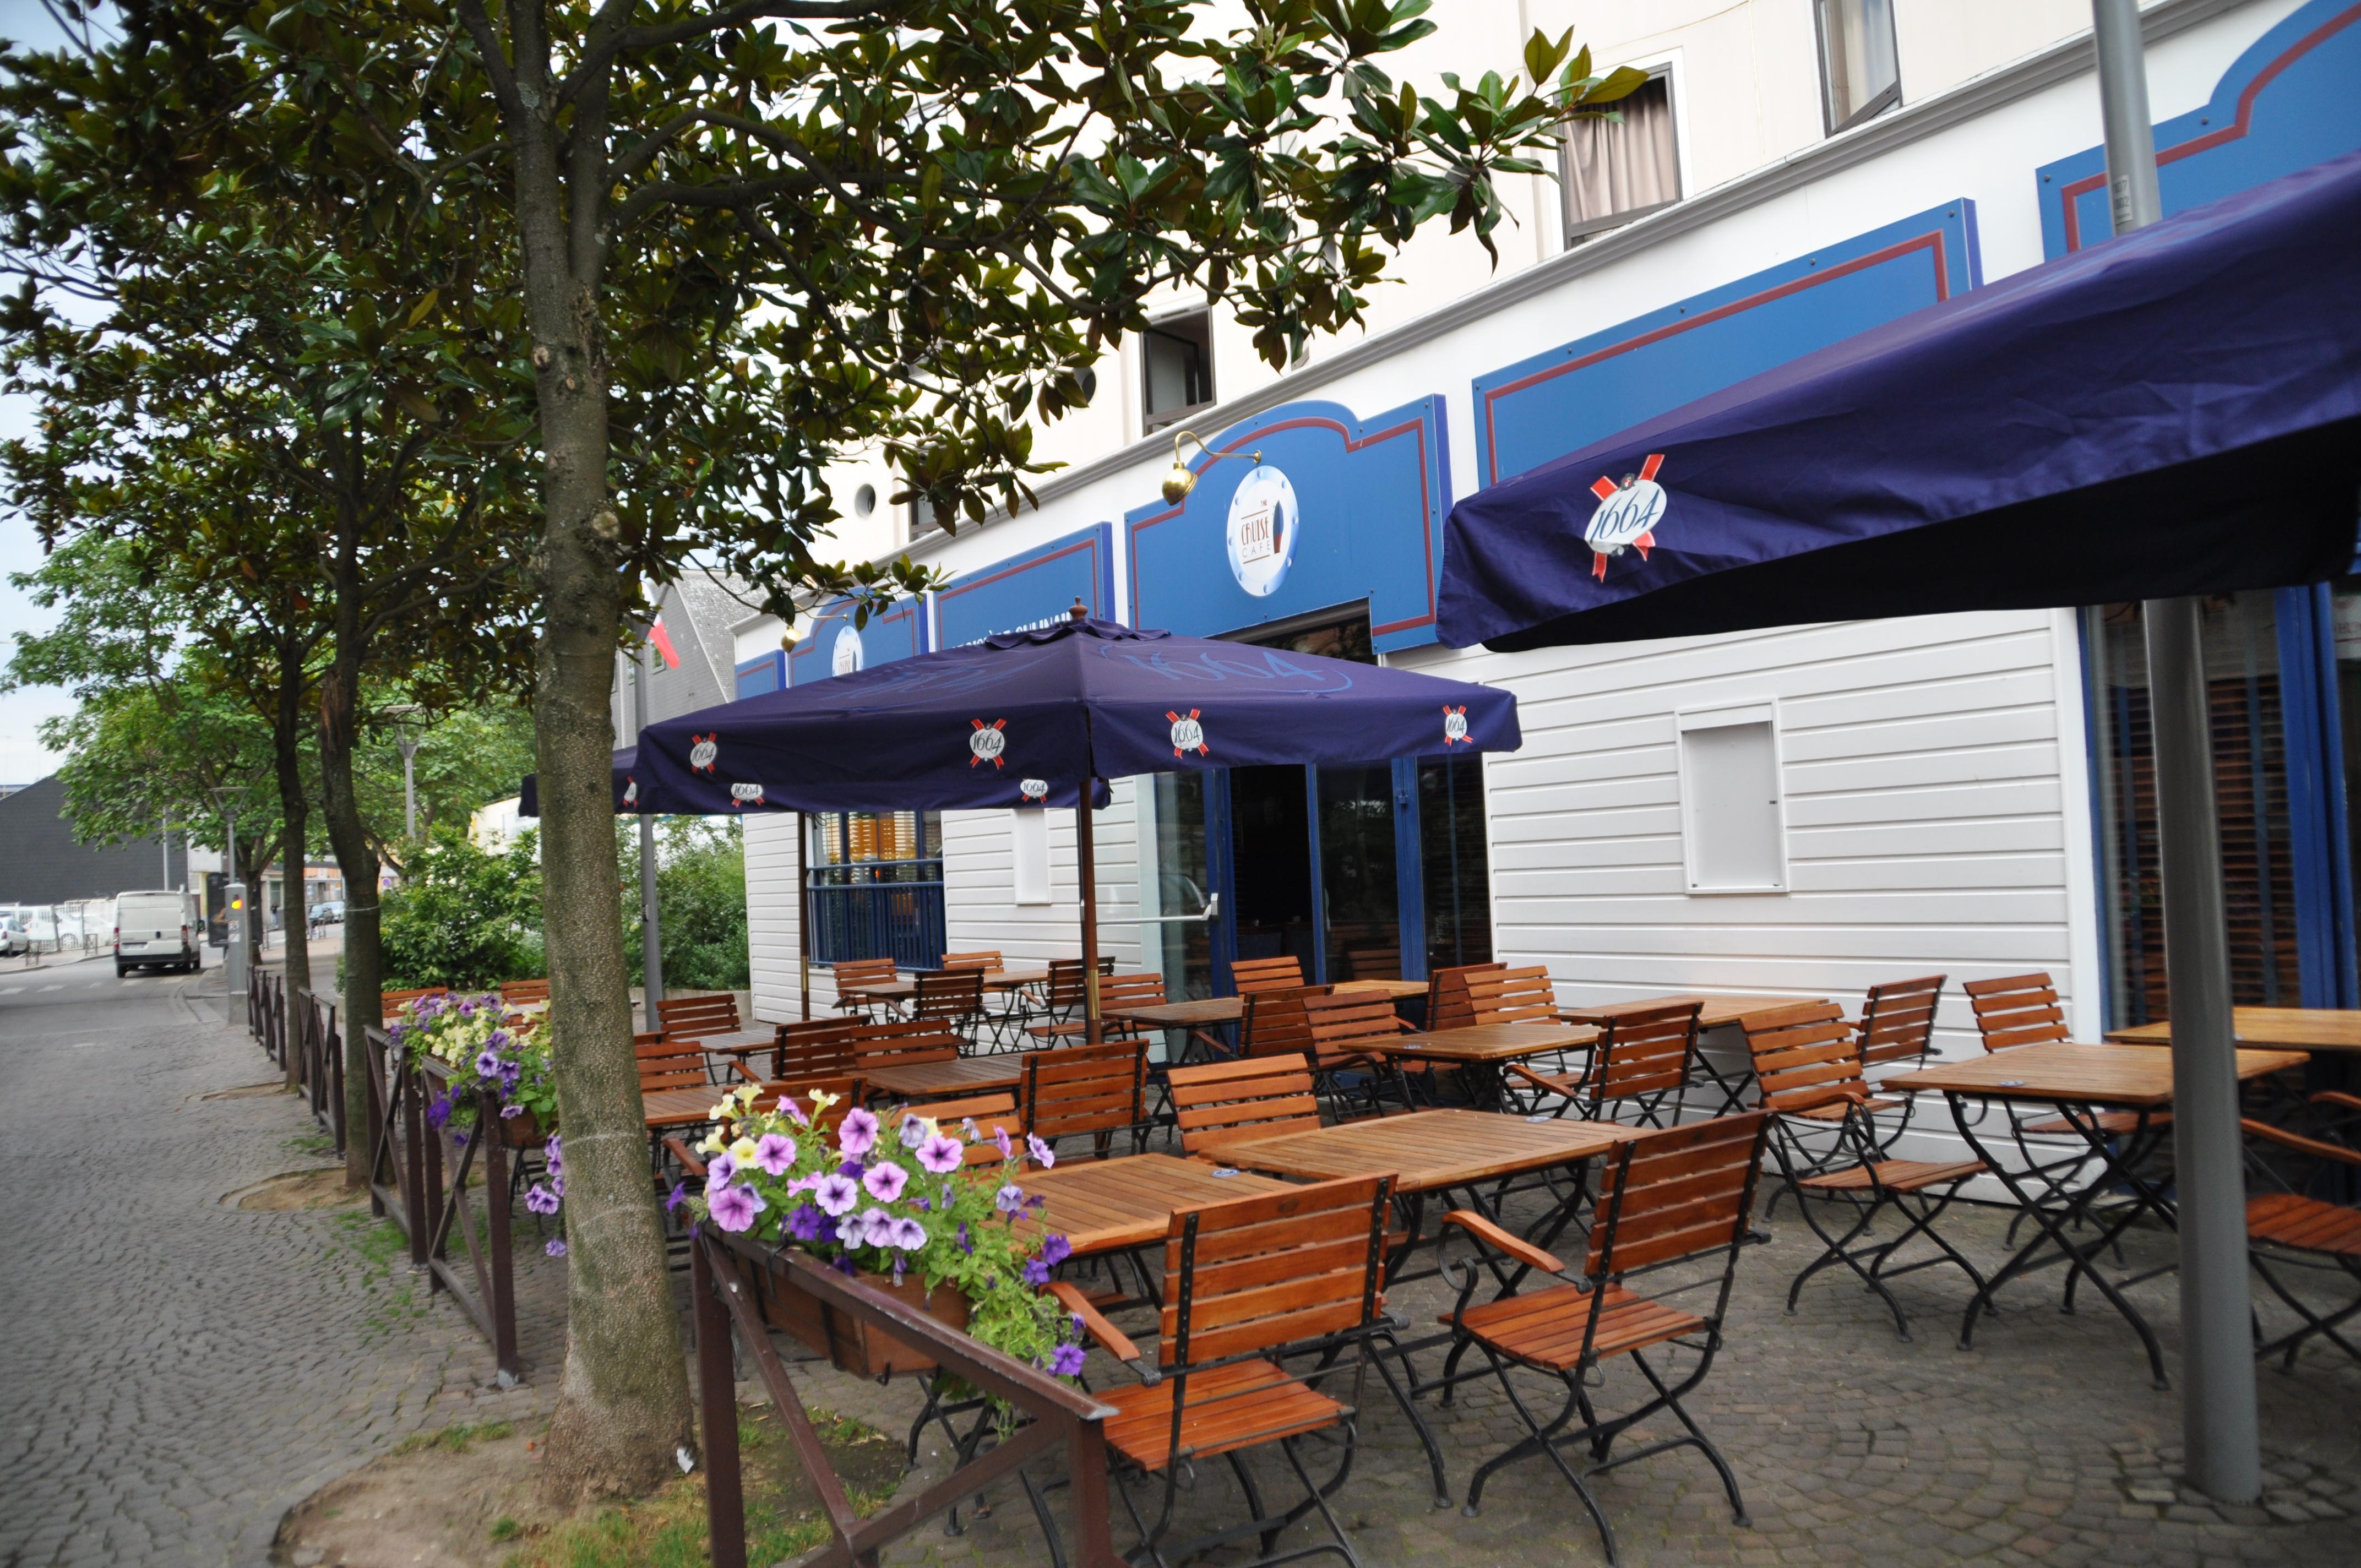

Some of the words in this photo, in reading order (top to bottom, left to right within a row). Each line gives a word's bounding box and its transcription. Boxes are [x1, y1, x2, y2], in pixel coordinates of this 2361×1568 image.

[1590, 488, 1660, 545] 1664
[1242, 517, 1269, 545] CRUISE
[1124, 651, 1326, 682] 1664
[1174, 723, 1200, 744] 1664
[1446, 717, 1466, 734] 1664
[973, 731, 1002, 754] 1664
[692, 744, 715, 763] 1664
[733, 783, 759, 796] 1664
[1023, 781, 1046, 793] 1664
